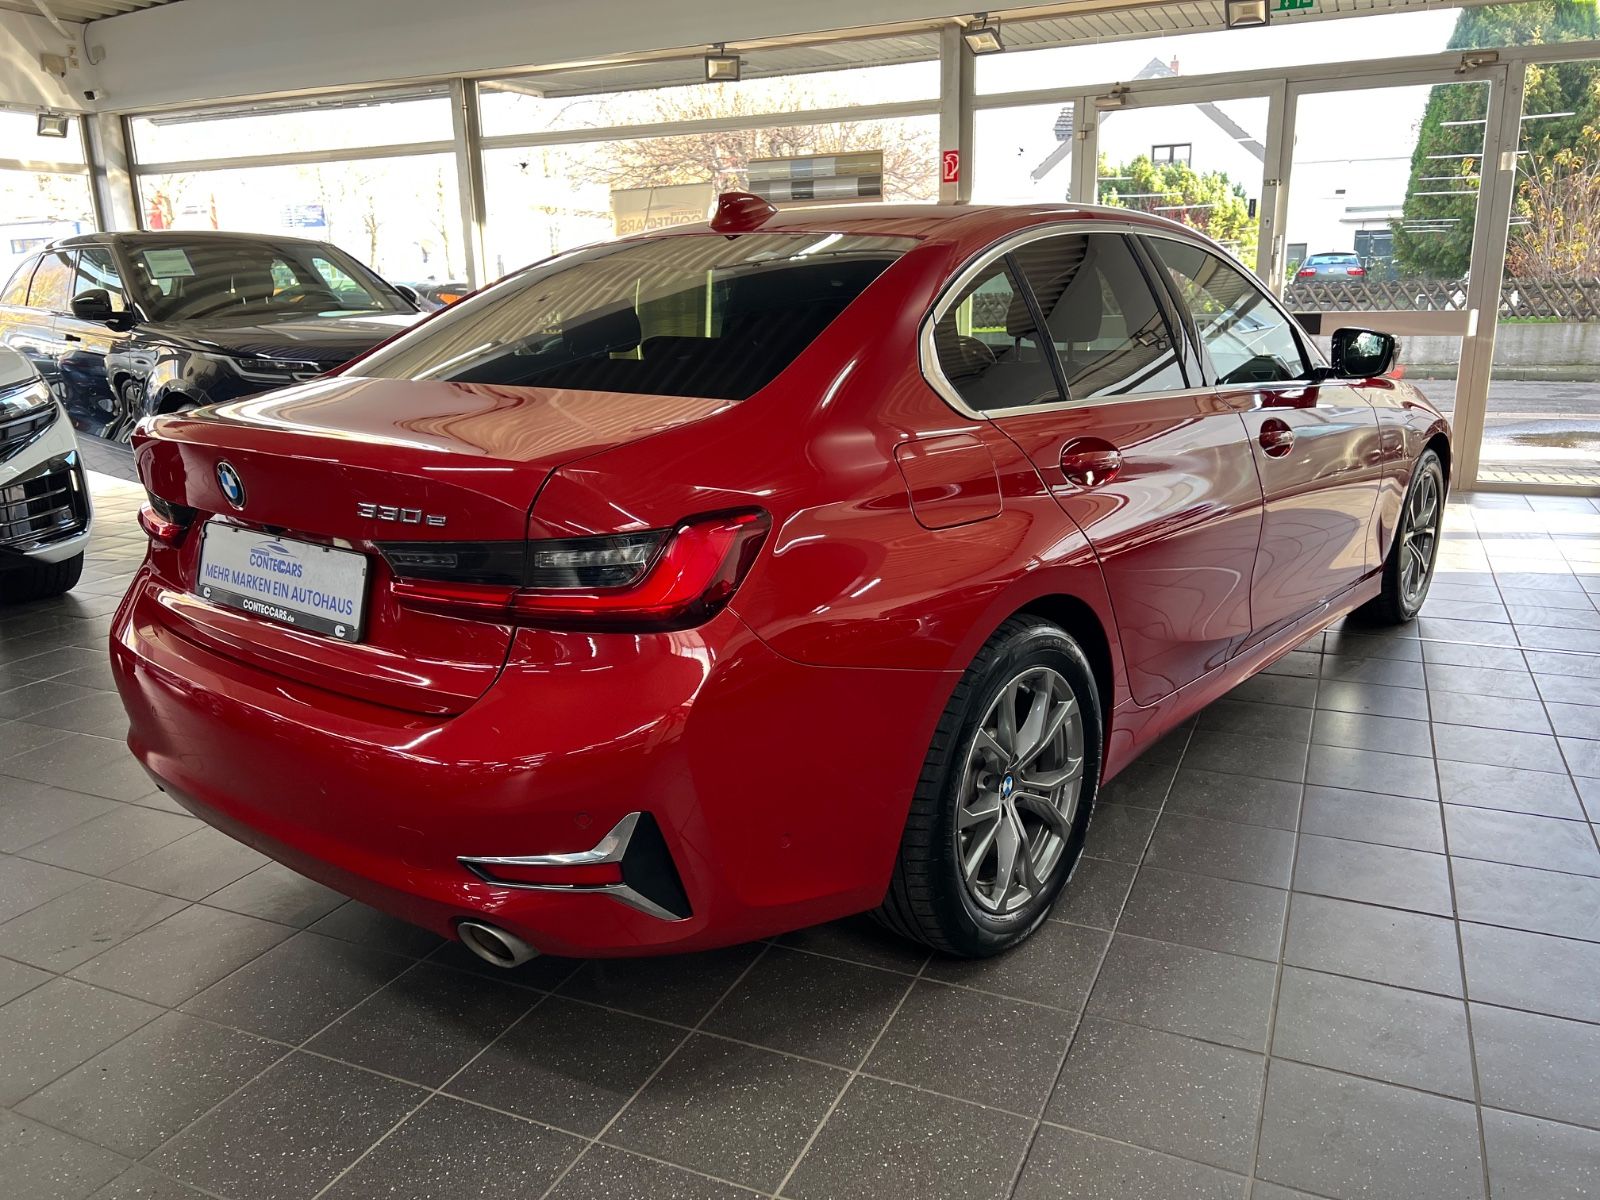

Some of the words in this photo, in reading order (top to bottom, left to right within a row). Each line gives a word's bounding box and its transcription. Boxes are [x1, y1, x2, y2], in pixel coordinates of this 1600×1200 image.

[206, 563, 229, 582] MEHR
[232, 571, 271, 594] MARKEN
[273, 581, 289, 599] EIN
[291, 586, 353, 615] AUTOHAUS
